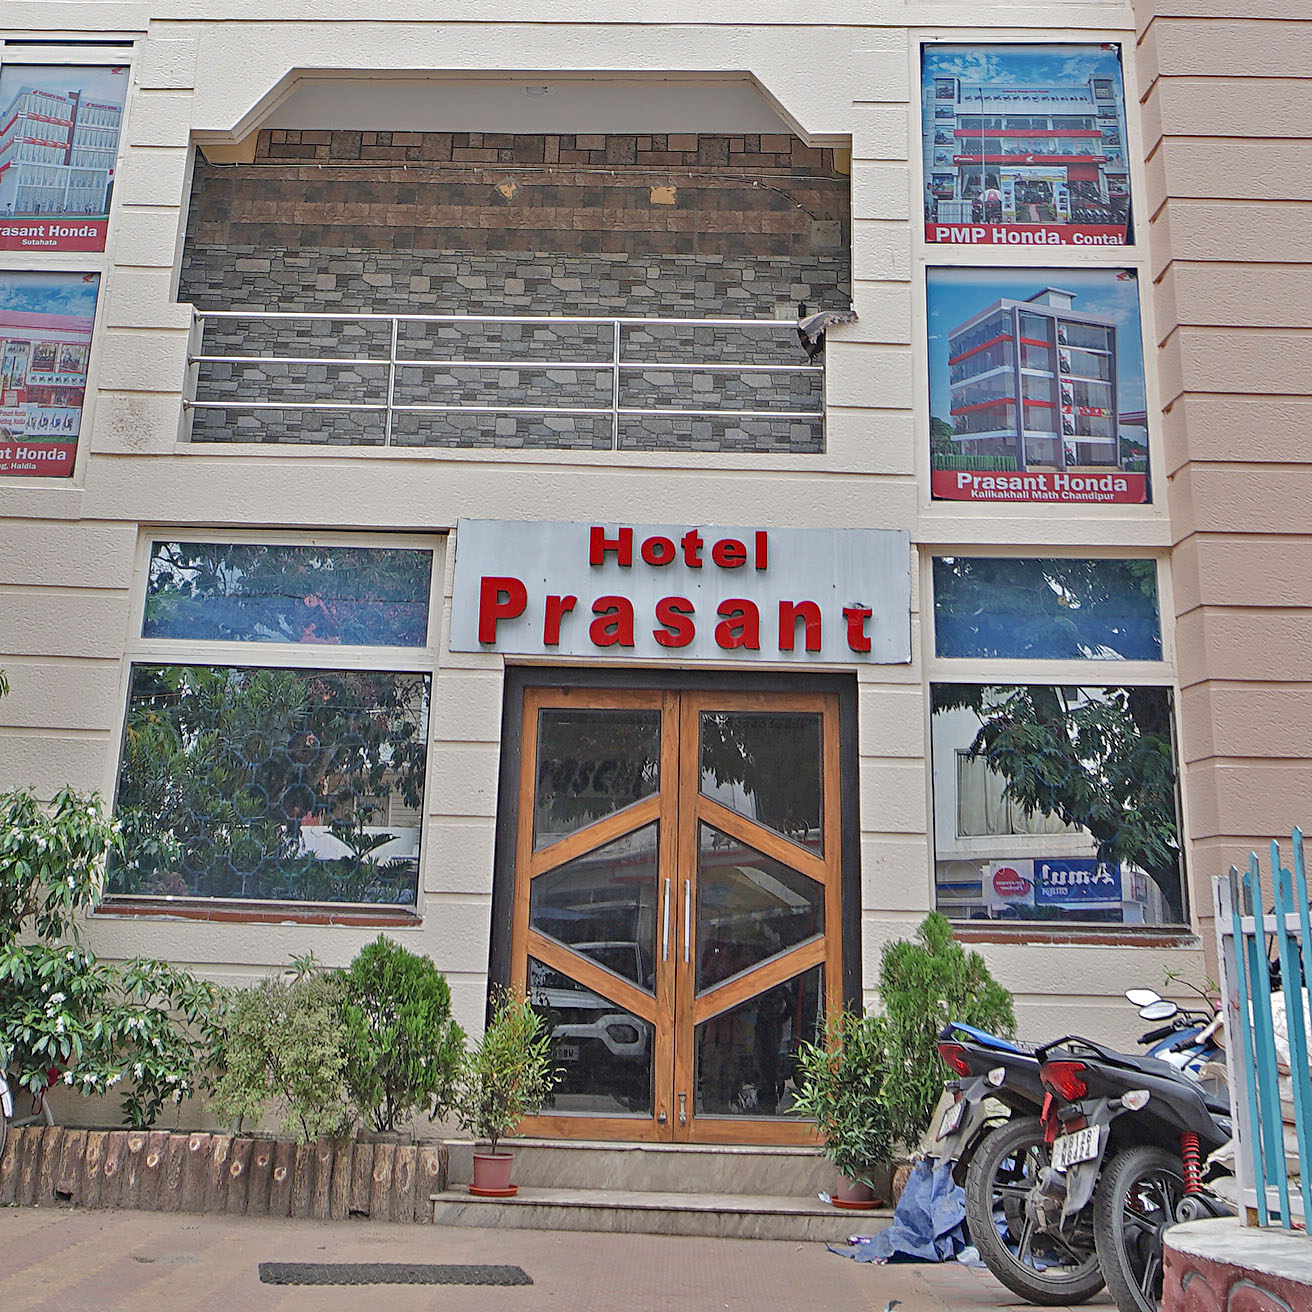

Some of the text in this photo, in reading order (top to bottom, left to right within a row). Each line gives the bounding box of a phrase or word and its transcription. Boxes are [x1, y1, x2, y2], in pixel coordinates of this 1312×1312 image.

[48, 225, 98, 237] Honda
[935, 227, 986, 243] PMP
[1072, 232, 1124, 245] Contai
[21, 238, 58, 246] Sutahata
[15, 447, 67, 461] Honda
[10, 462, 37, 470] Haldia
[956, 472, 1128, 492] Prasant Honda
[1032, 490, 1059, 500] Math
[1059, 491, 1115, 502] Chandipur
[589, 525, 769, 571] Hotel
[478, 575, 874, 653] Prasant
